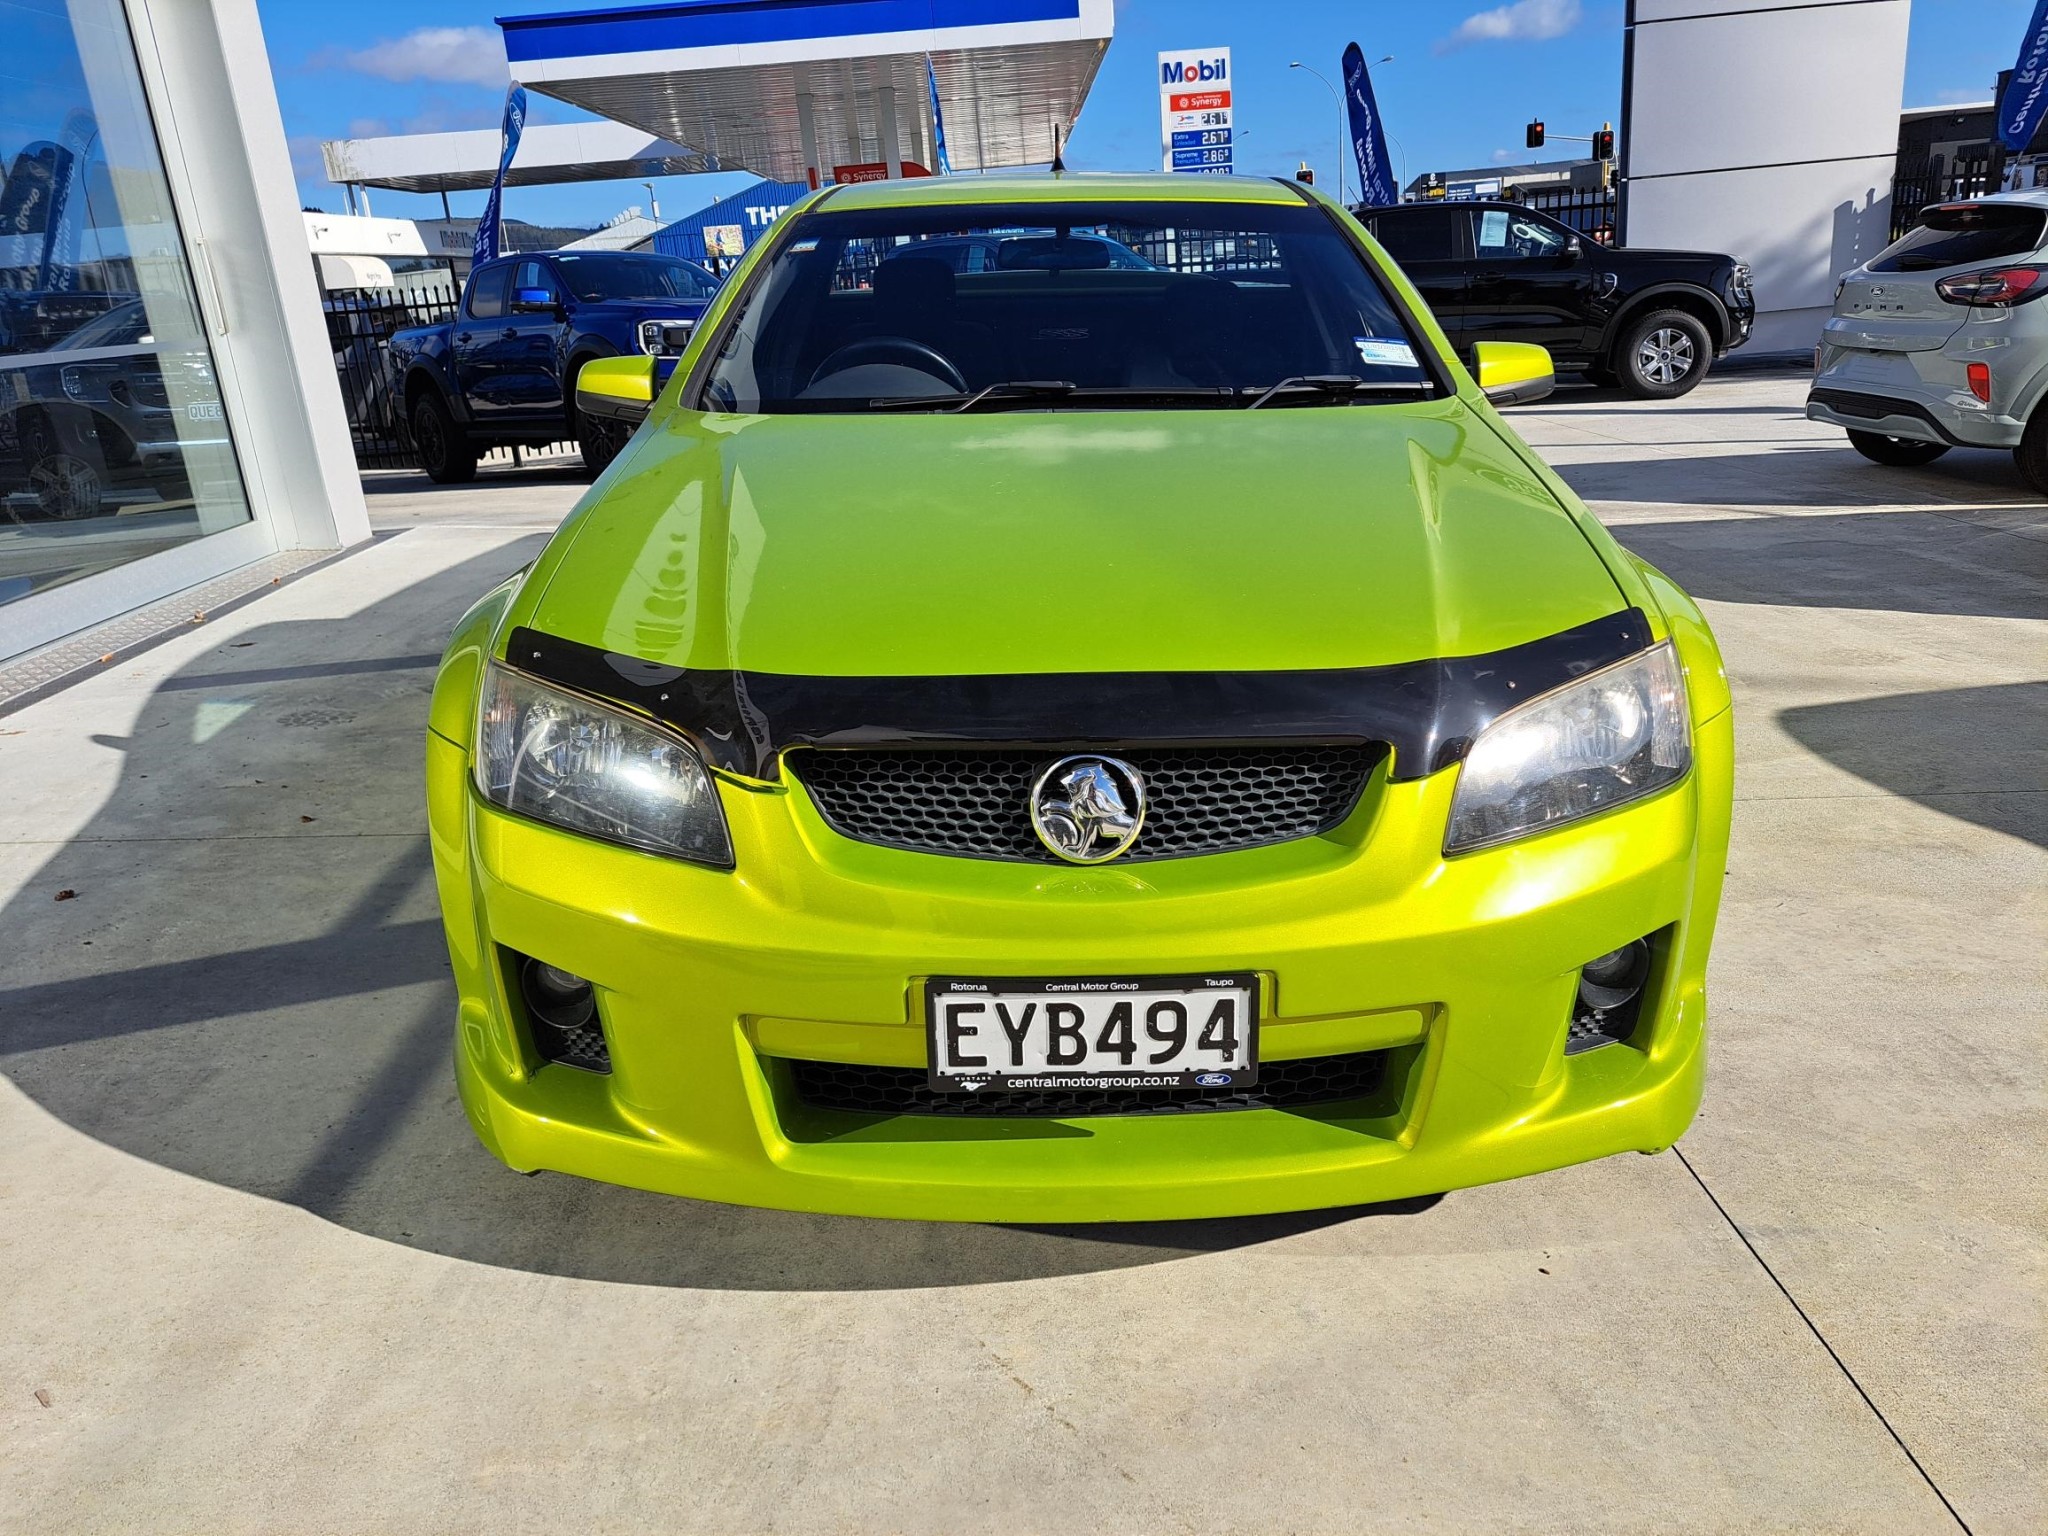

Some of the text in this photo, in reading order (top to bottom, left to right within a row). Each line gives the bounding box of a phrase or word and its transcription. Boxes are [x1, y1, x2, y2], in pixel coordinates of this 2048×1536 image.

[1162, 58, 1226, 84] Mobil
[1191, 97, 1222, 107] Synergy
[1174, 152, 1198, 160] Supreme
[853, 172, 887, 182] Synergy
[15, 188, 41, 231] Group
[1854, 303, 1904, 311] PUMA
[950, 982, 988, 991] Rotorua
[1045, 982, 1139, 992] Central Motor Group
[1204, 978, 1234, 987] Taupo
[945, 998, 1239, 1068] EYB494
[1007, 1075, 1180, 1088] centralmotorgroup.co.nz
[1200, 1074, 1226, 1085] Ford
